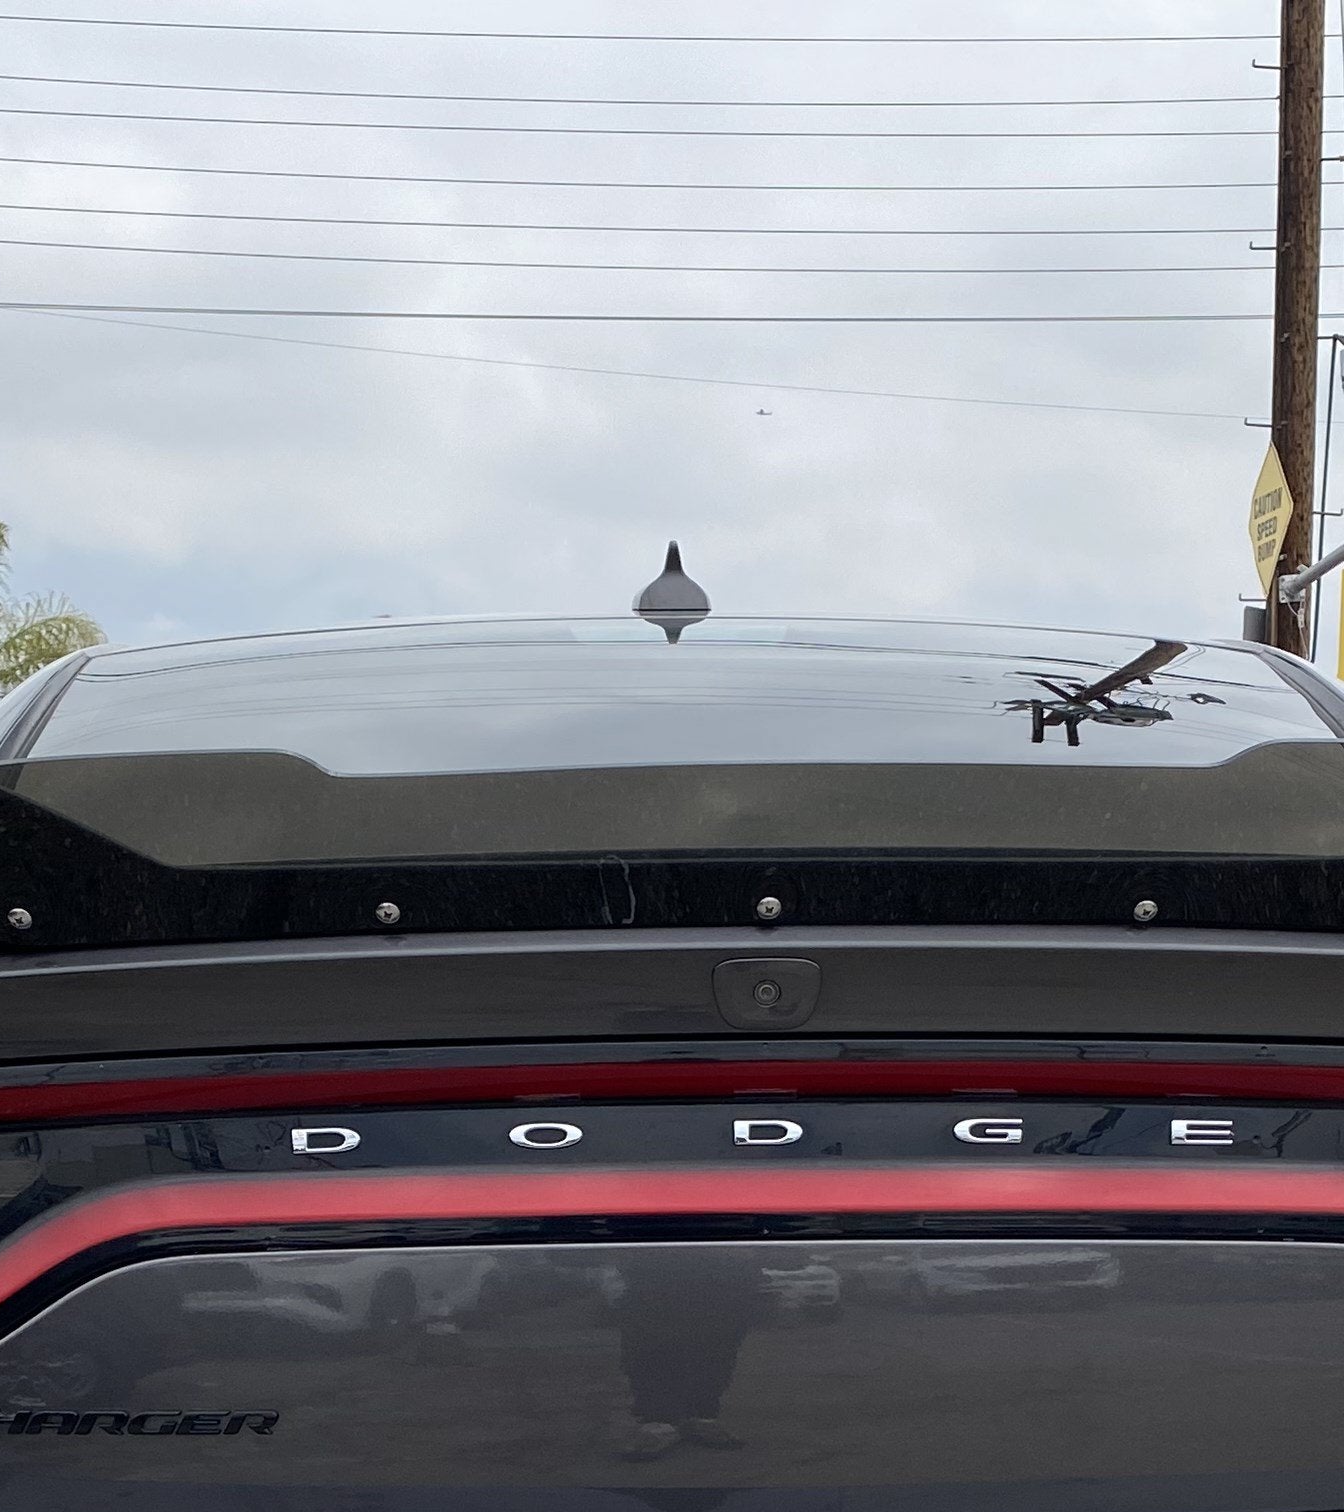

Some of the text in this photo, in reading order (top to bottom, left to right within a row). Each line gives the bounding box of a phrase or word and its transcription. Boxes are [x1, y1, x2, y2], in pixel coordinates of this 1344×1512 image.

[1254, 487, 1282, 519] CAUTION
[1257, 516, 1277, 541] SPEED
[1258, 539, 1276, 562] BUMP
[291, 1117, 1234, 1154] DODGE
